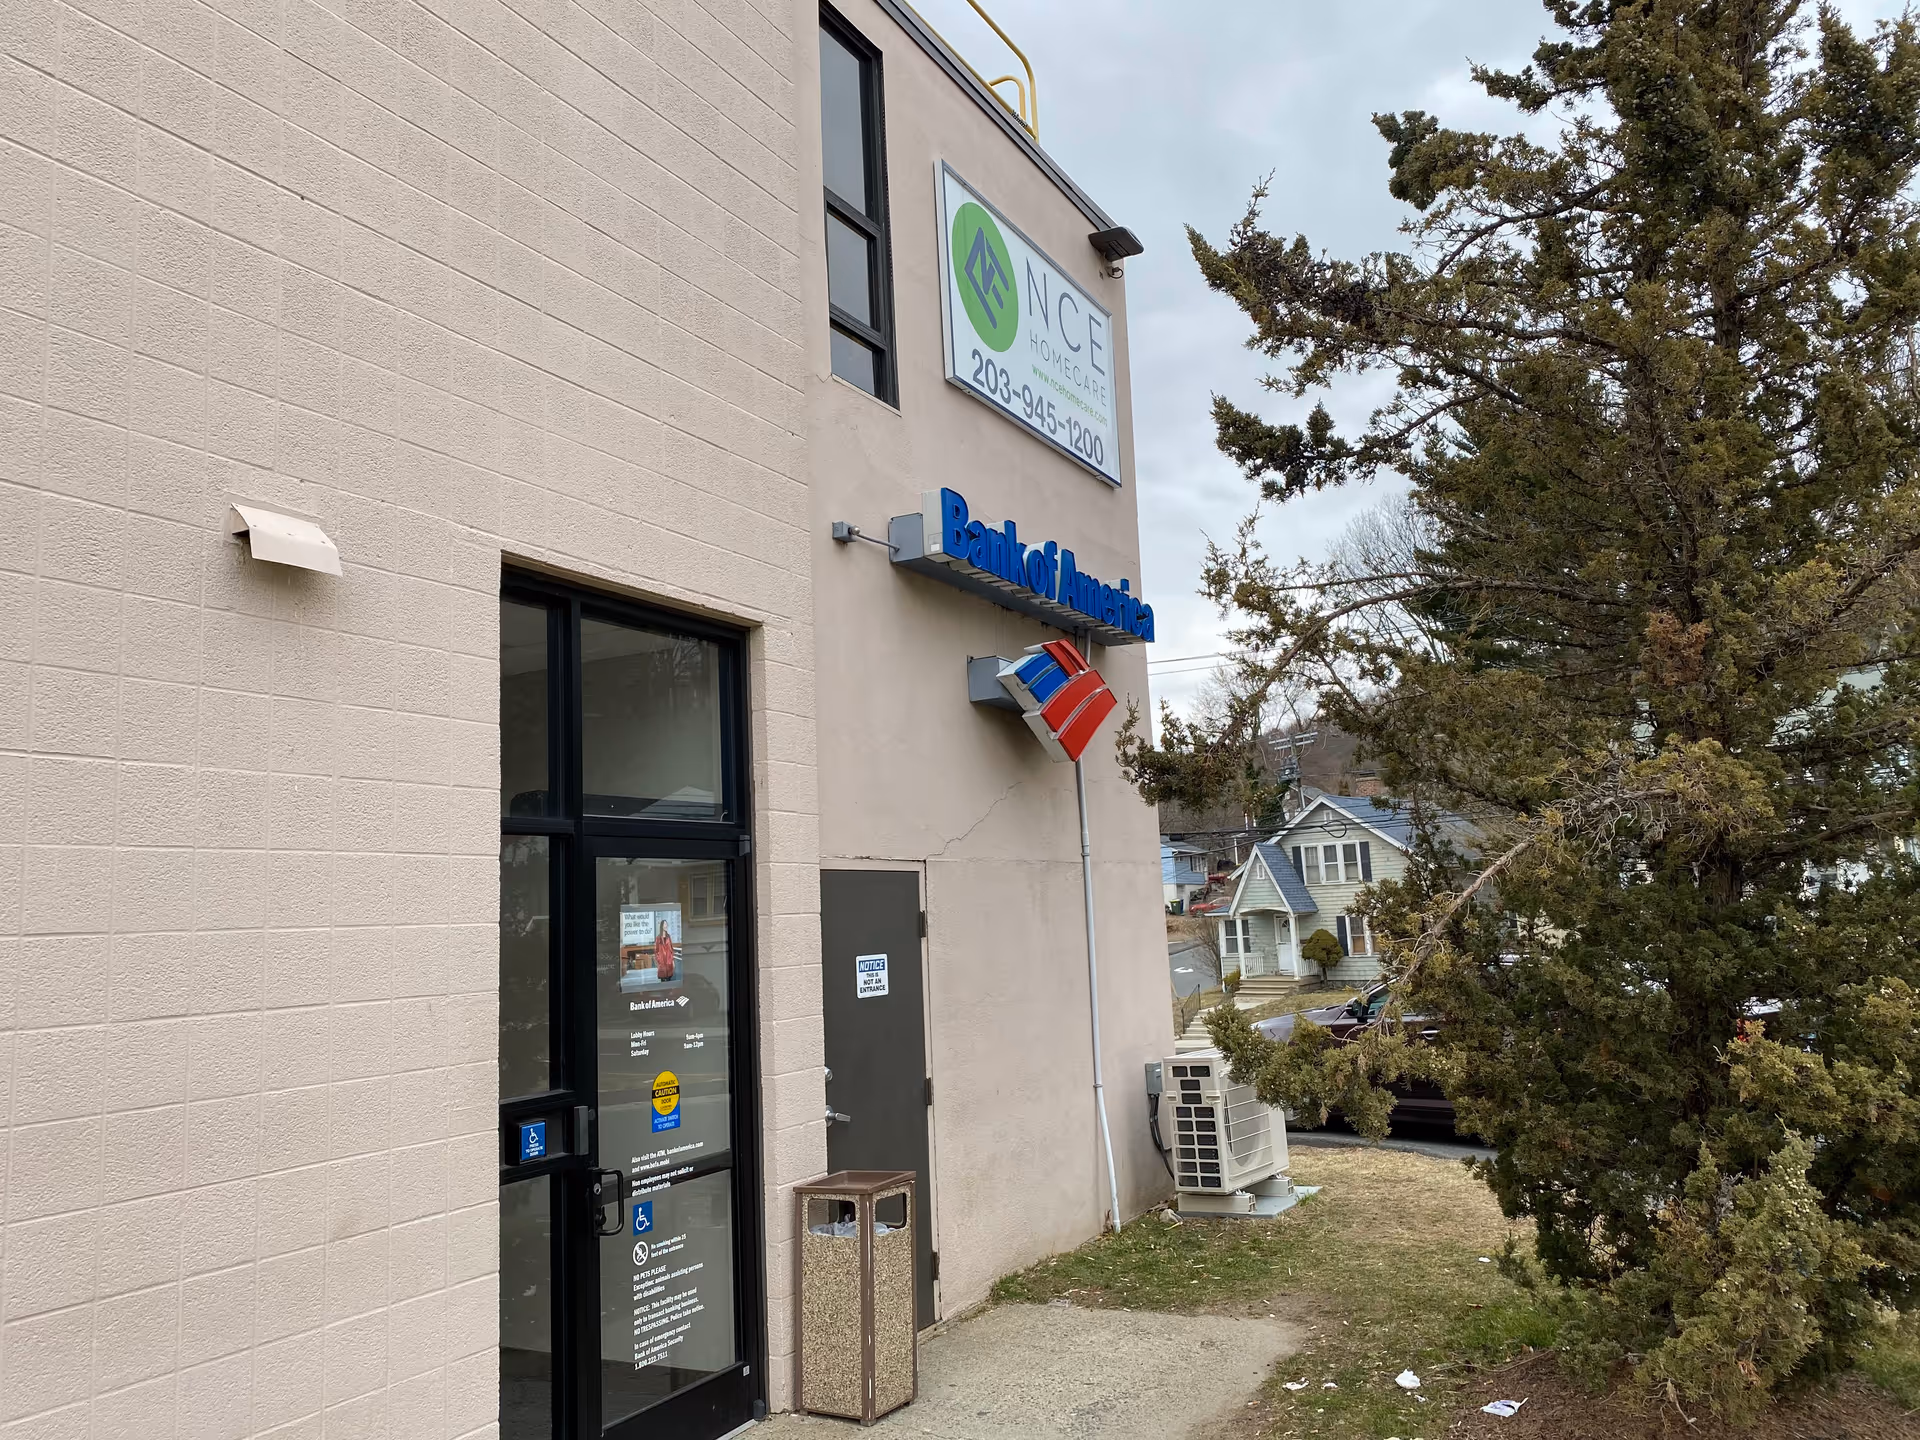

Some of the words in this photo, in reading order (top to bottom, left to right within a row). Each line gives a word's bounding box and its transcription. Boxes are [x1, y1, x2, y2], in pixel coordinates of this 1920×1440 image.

[1026, 256, 1106, 376] NCE
[1030, 330, 1106, 407] HOMECARE
[972, 348, 1104, 466] 203-945-1200
[1032, 364, 1108, 428] www.ncehomecare.com
[940, 487, 1028, 588] Bank
[1025, 540, 1058, 600] of
[1058, 548, 1154, 642] America
[860, 960, 884, 971] NOTICE
[860, 985, 885, 993] ENTRANCE
[630, 1001, 645, 1011] Bank
[652, 999, 674, 1008] America
[655, 1087, 676, 1097] CAUTION
[641, 1174, 661, 1185] employees
[678, 1167, 689, 1175] solicit
[632, 1186, 651, 1197] distribute
[669, 1244, 684, 1252] entrance
[640, 1270, 650, 1279] PETS
[651, 1264, 667, 1276] PLEASE
[655, 1273, 670, 1284] animals
[671, 1268, 688, 1278] assisting
[688, 1262, 704, 1273] persons
[633, 1292, 642, 1301] with
[643, 1285, 665, 1297] disabilities
[634, 1304, 650, 1316] NOTICE:
[660, 1296, 673, 1305] facility
[688, 1287, 697, 1295] used
[634, 1318, 642, 1326] only
[648, 1309, 665, 1320] transact
[665, 1303, 681, 1314] banking
[681, 1297, 699, 1308] business.
[634, 1328, 640, 1336] NO
[670, 1312, 682, 1321] Police
[692, 1304, 704, 1314] notice.
[639, 1340, 649, 1348] case
[654, 1329, 676, 1342] emergency
[676, 1322, 691, 1333] contact
[635, 1351, 645, 1360] Bank
[646, 1348, 650, 1356] of
[650, 1342, 667, 1353] America
[668, 1335, 683, 1346] Security
